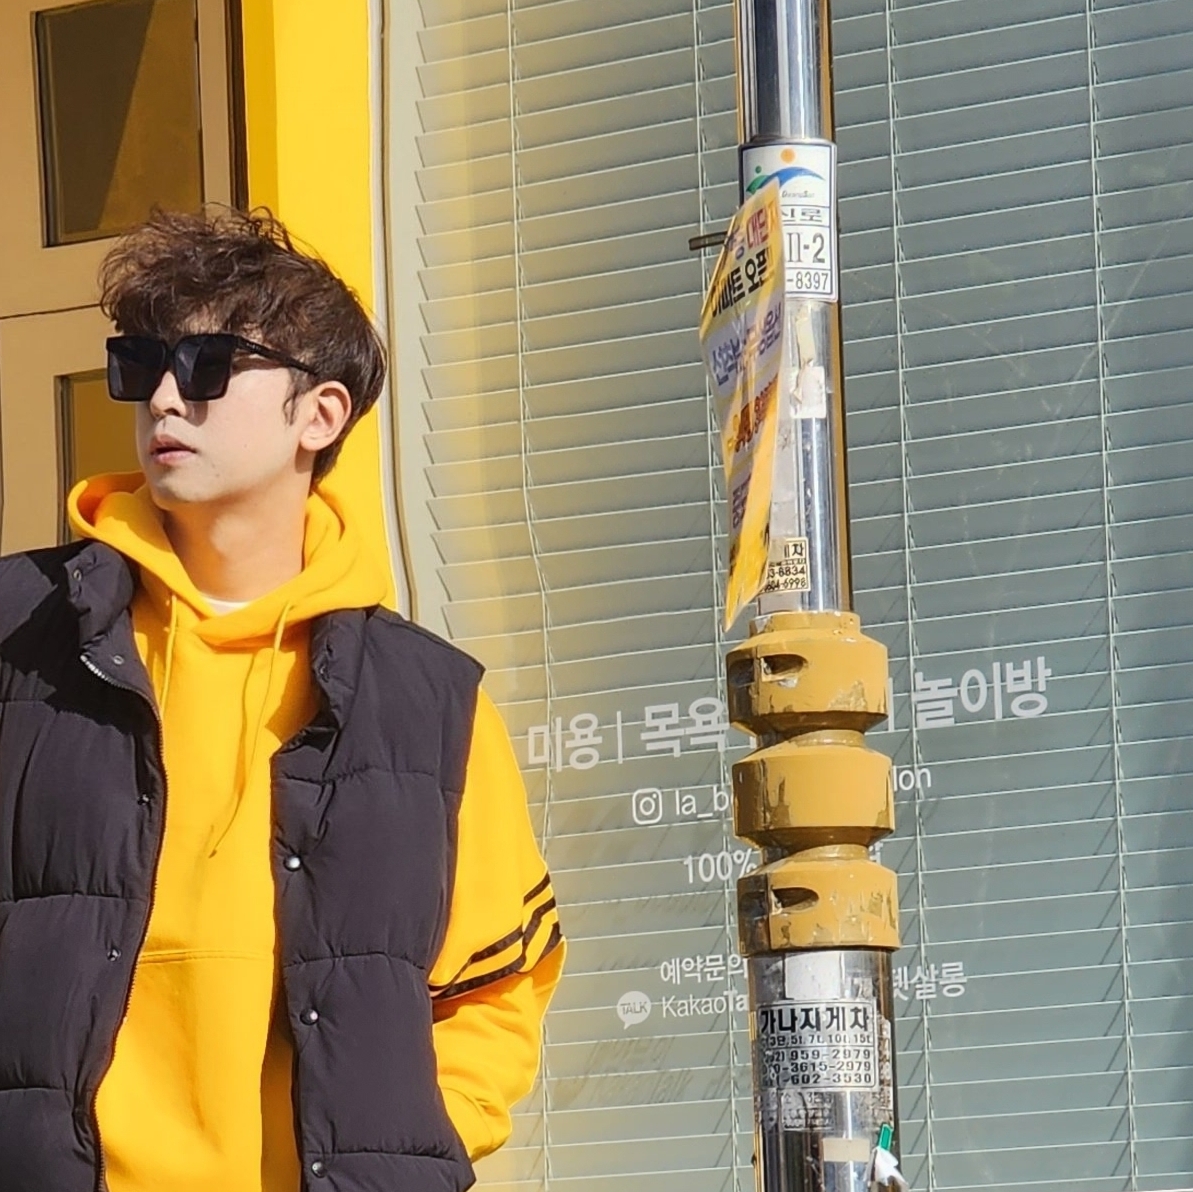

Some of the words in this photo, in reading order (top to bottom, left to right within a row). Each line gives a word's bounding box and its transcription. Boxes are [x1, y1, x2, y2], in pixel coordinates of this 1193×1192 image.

[781, 207, 823, 223] 신로
[786, 270, 829, 291] -8397
[527, 712, 604, 773] 미용
[640, 697, 730, 758] 목욕
[912, 655, 1052, 730] 놀이방
[892, 765, 932, 792] lon
[683, 848, 758, 884] 100%
[660, 953, 749, 985] 예약문의
[620, 1000, 648, 1016] TALK
[662, 989, 749, 1019] KakaoTa
